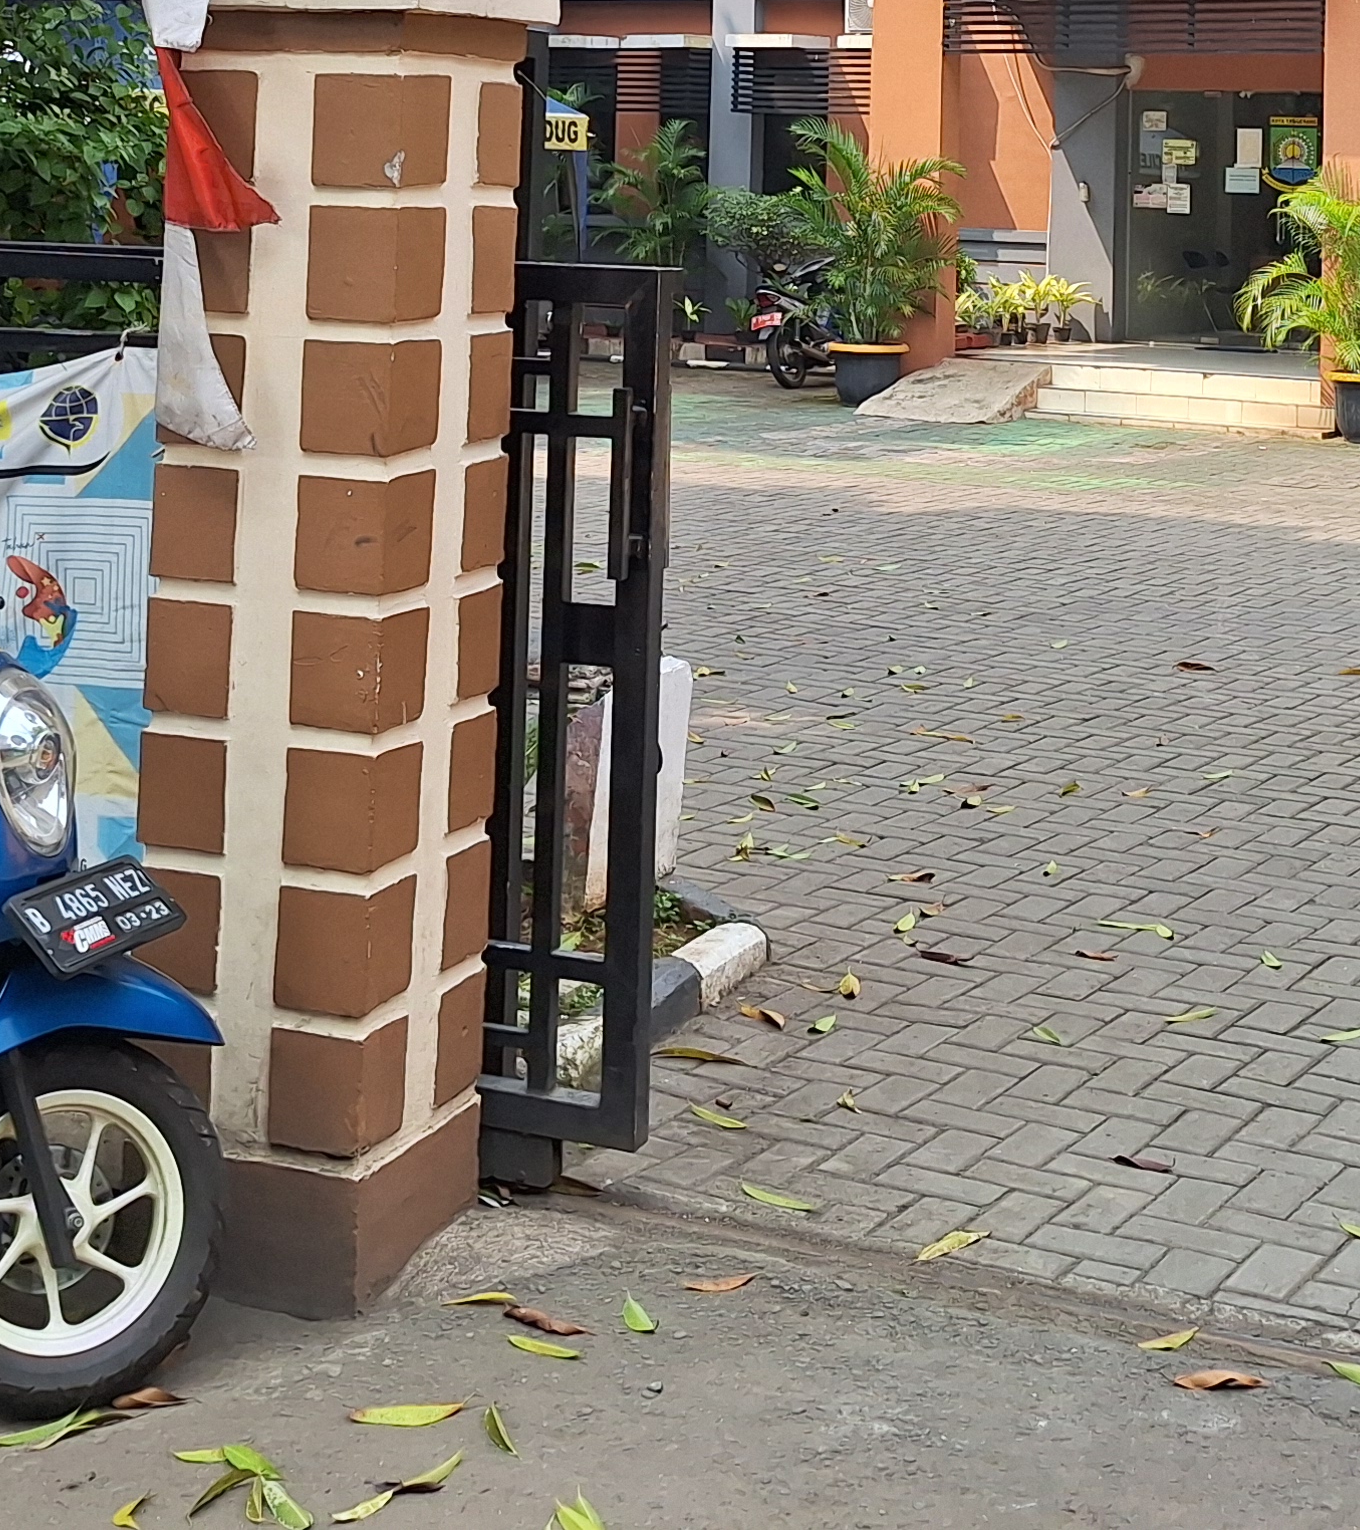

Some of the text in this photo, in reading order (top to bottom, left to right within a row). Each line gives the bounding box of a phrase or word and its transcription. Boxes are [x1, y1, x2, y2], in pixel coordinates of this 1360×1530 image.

[24, 869, 152, 934] B 4865 NEZ
